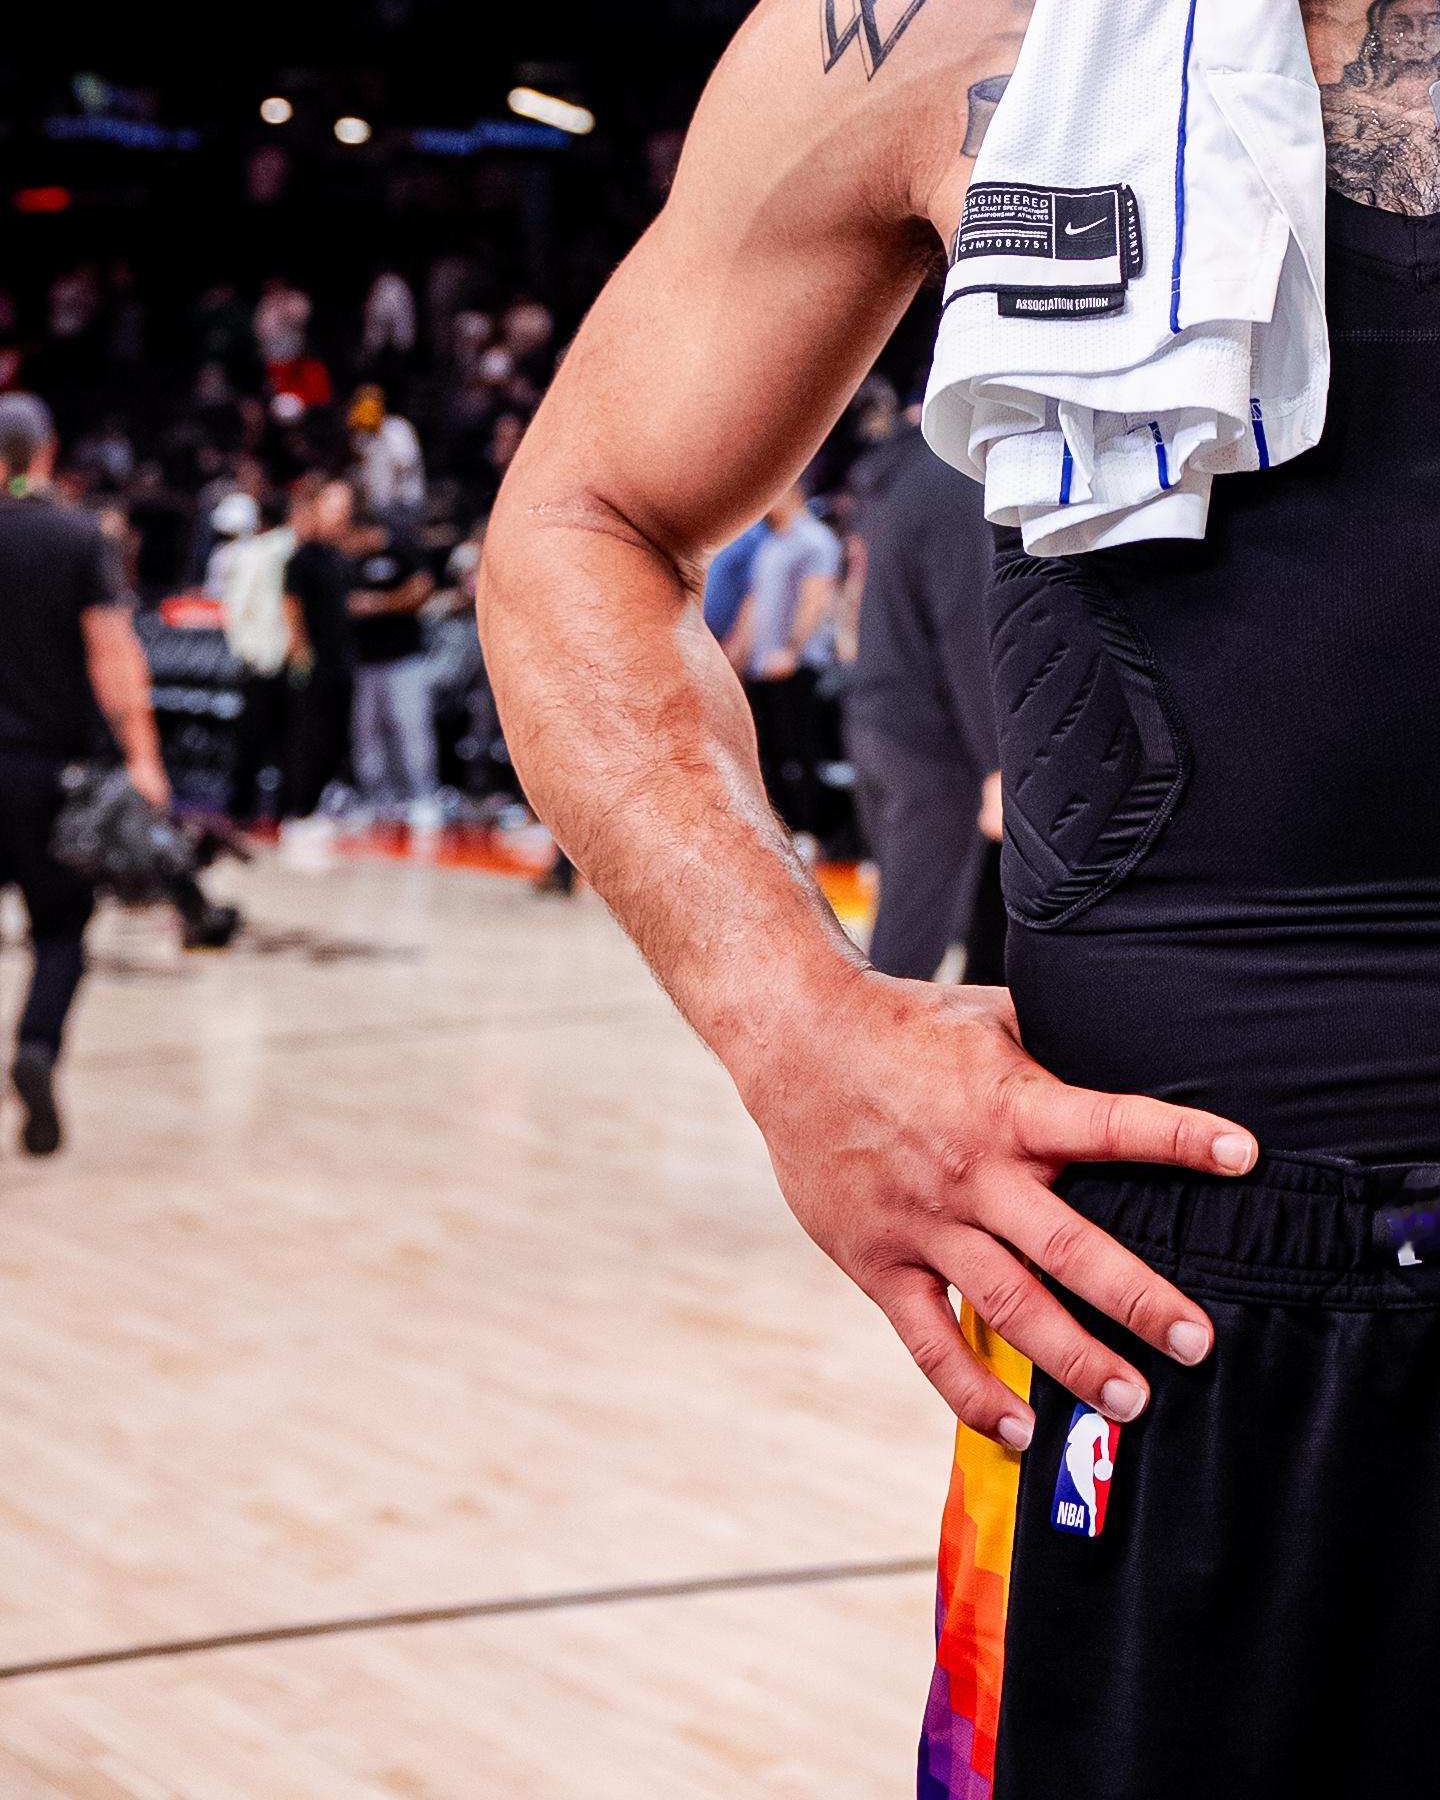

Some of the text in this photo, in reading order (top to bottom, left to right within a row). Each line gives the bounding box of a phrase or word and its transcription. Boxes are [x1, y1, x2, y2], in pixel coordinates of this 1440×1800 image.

[964, 194, 1049, 210] ENGINEERED
[1016, 297, 1109, 311] ASSOCIATION EDITION
[1056, 1501, 1085, 1529] NBA
